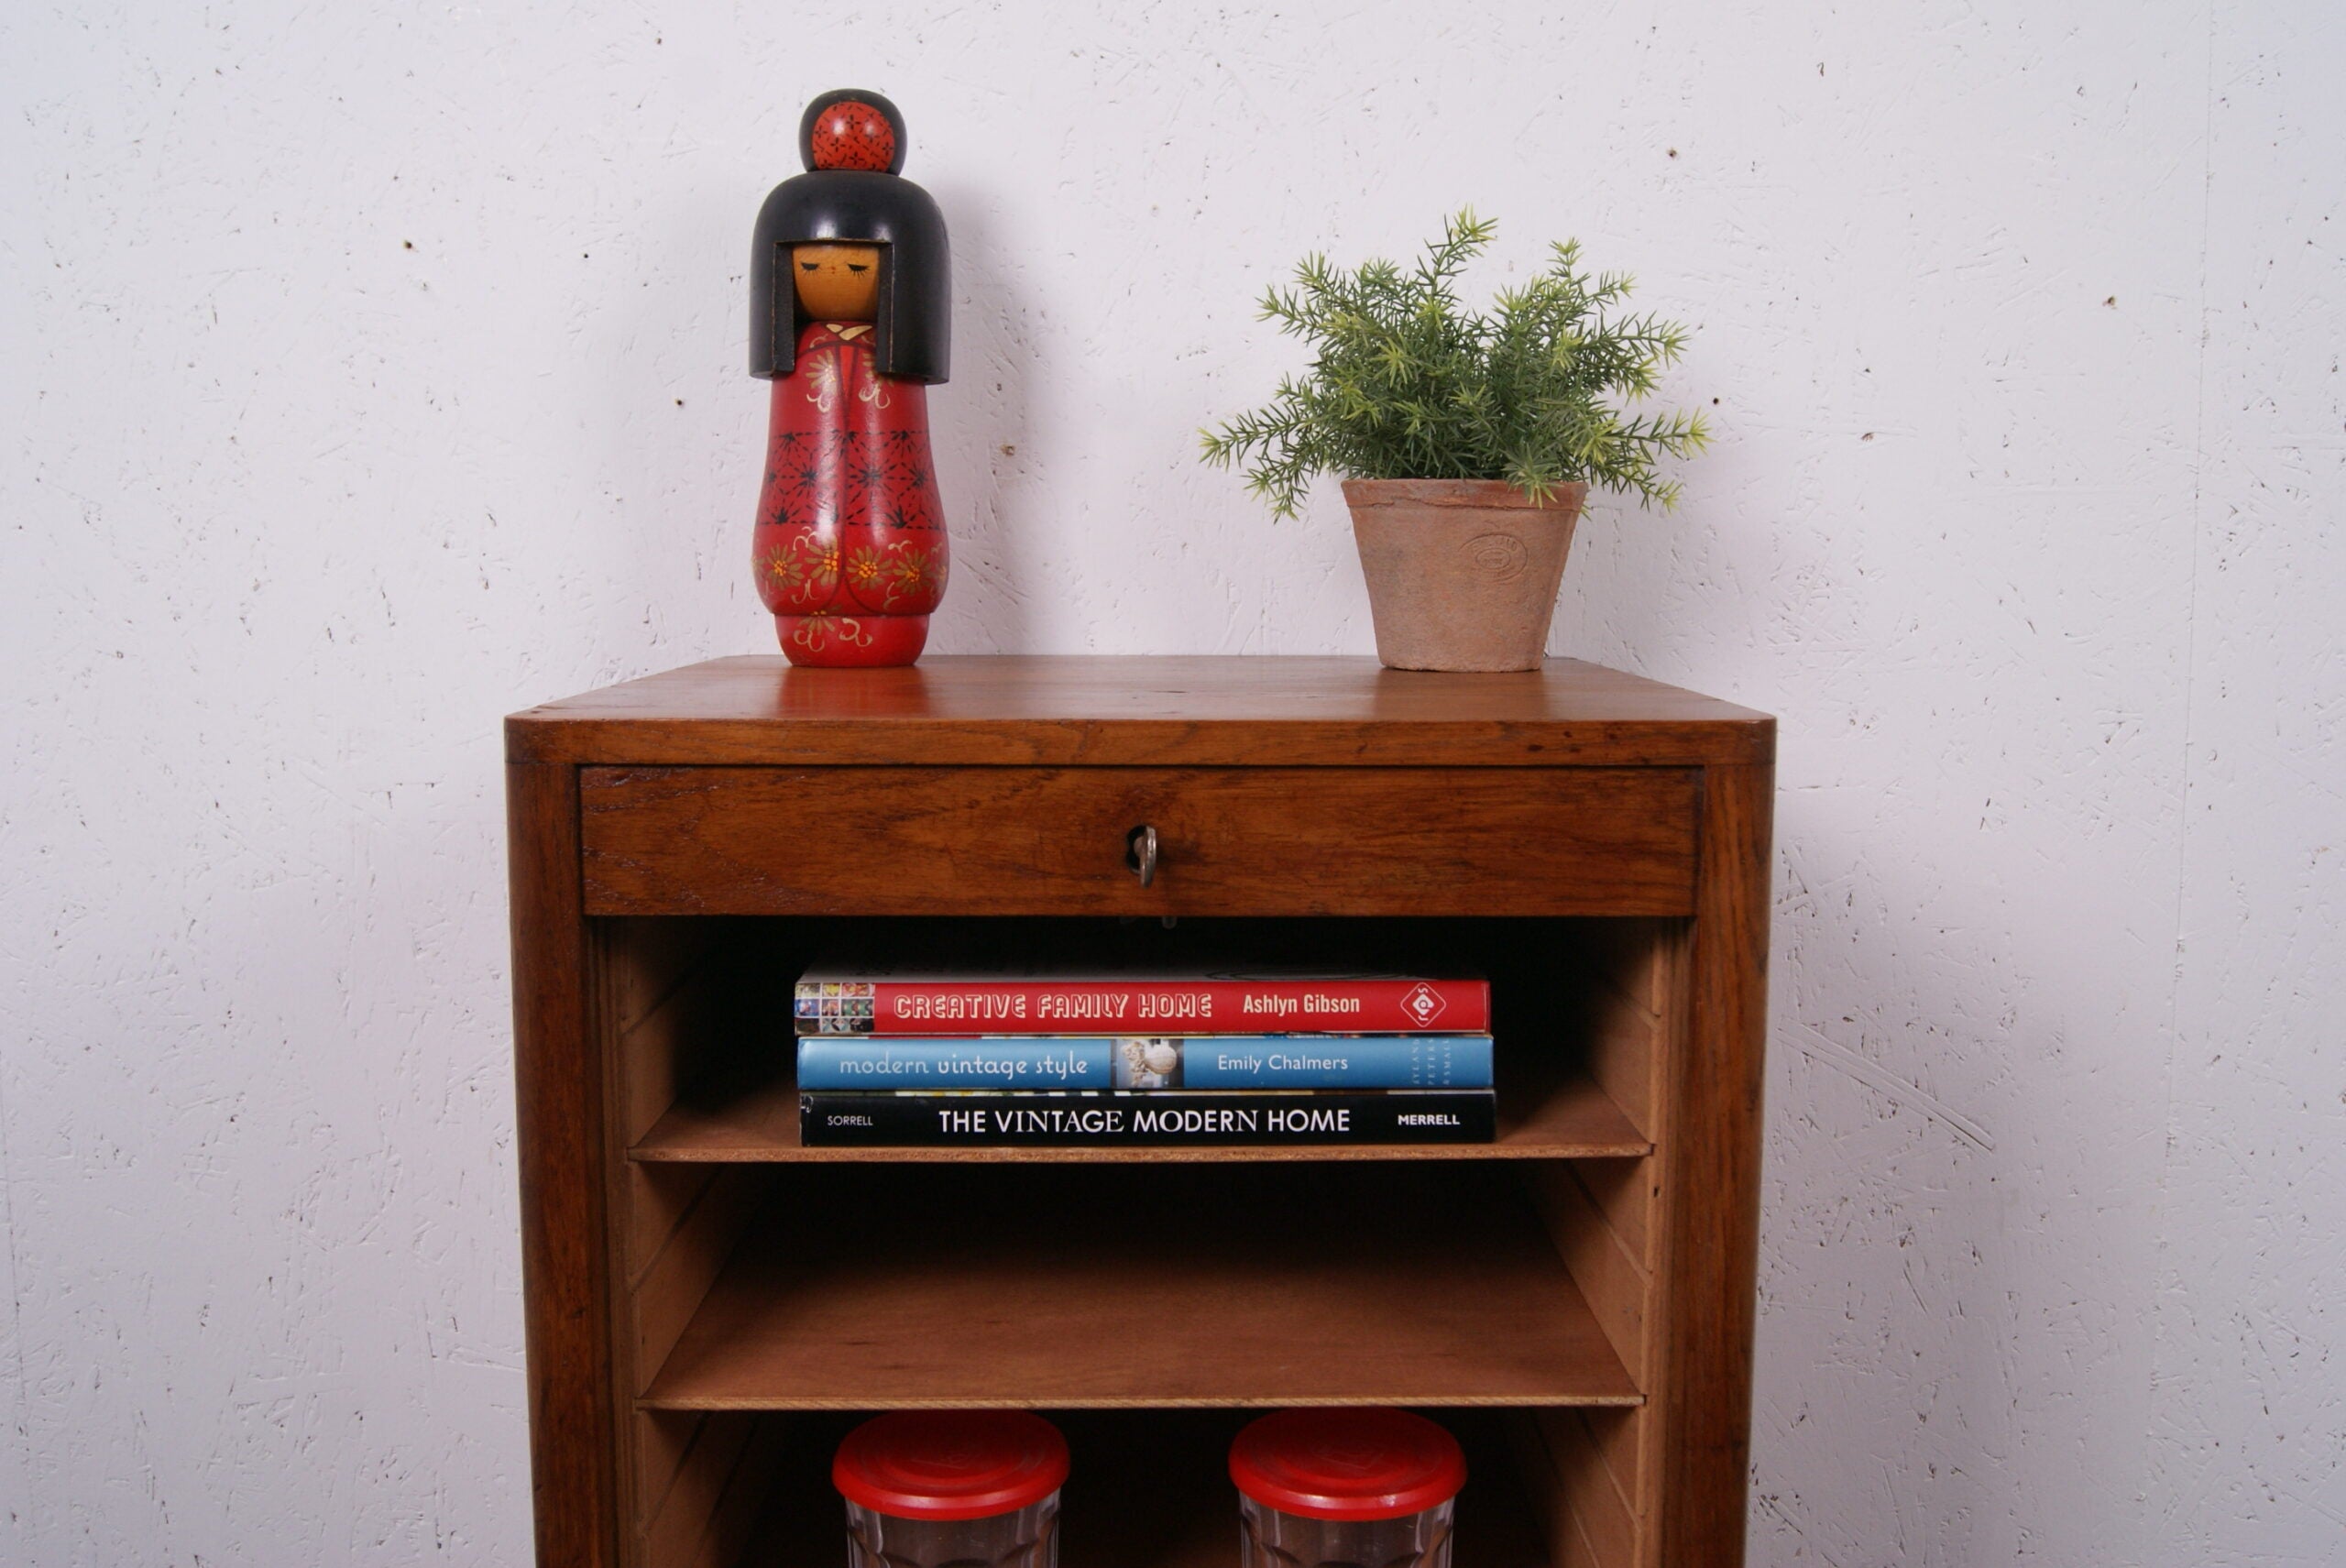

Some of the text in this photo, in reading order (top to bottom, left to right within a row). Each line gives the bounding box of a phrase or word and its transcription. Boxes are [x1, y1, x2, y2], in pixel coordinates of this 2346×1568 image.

[893, 992, 1211, 1018] CREATIVE FAMILY HOME
[1242, 993, 1360, 1016] Ashlyn Gibson
[839, 1049, 1088, 1080] modern vintage style
[1217, 1053, 1348, 1074] Emily Chalmers
[826, 1114, 873, 1126] SORRELL
[937, 1108, 1350, 1133] THE VINTAGE MODERN HOME
[1396, 1113, 1461, 1125] MERRELL
